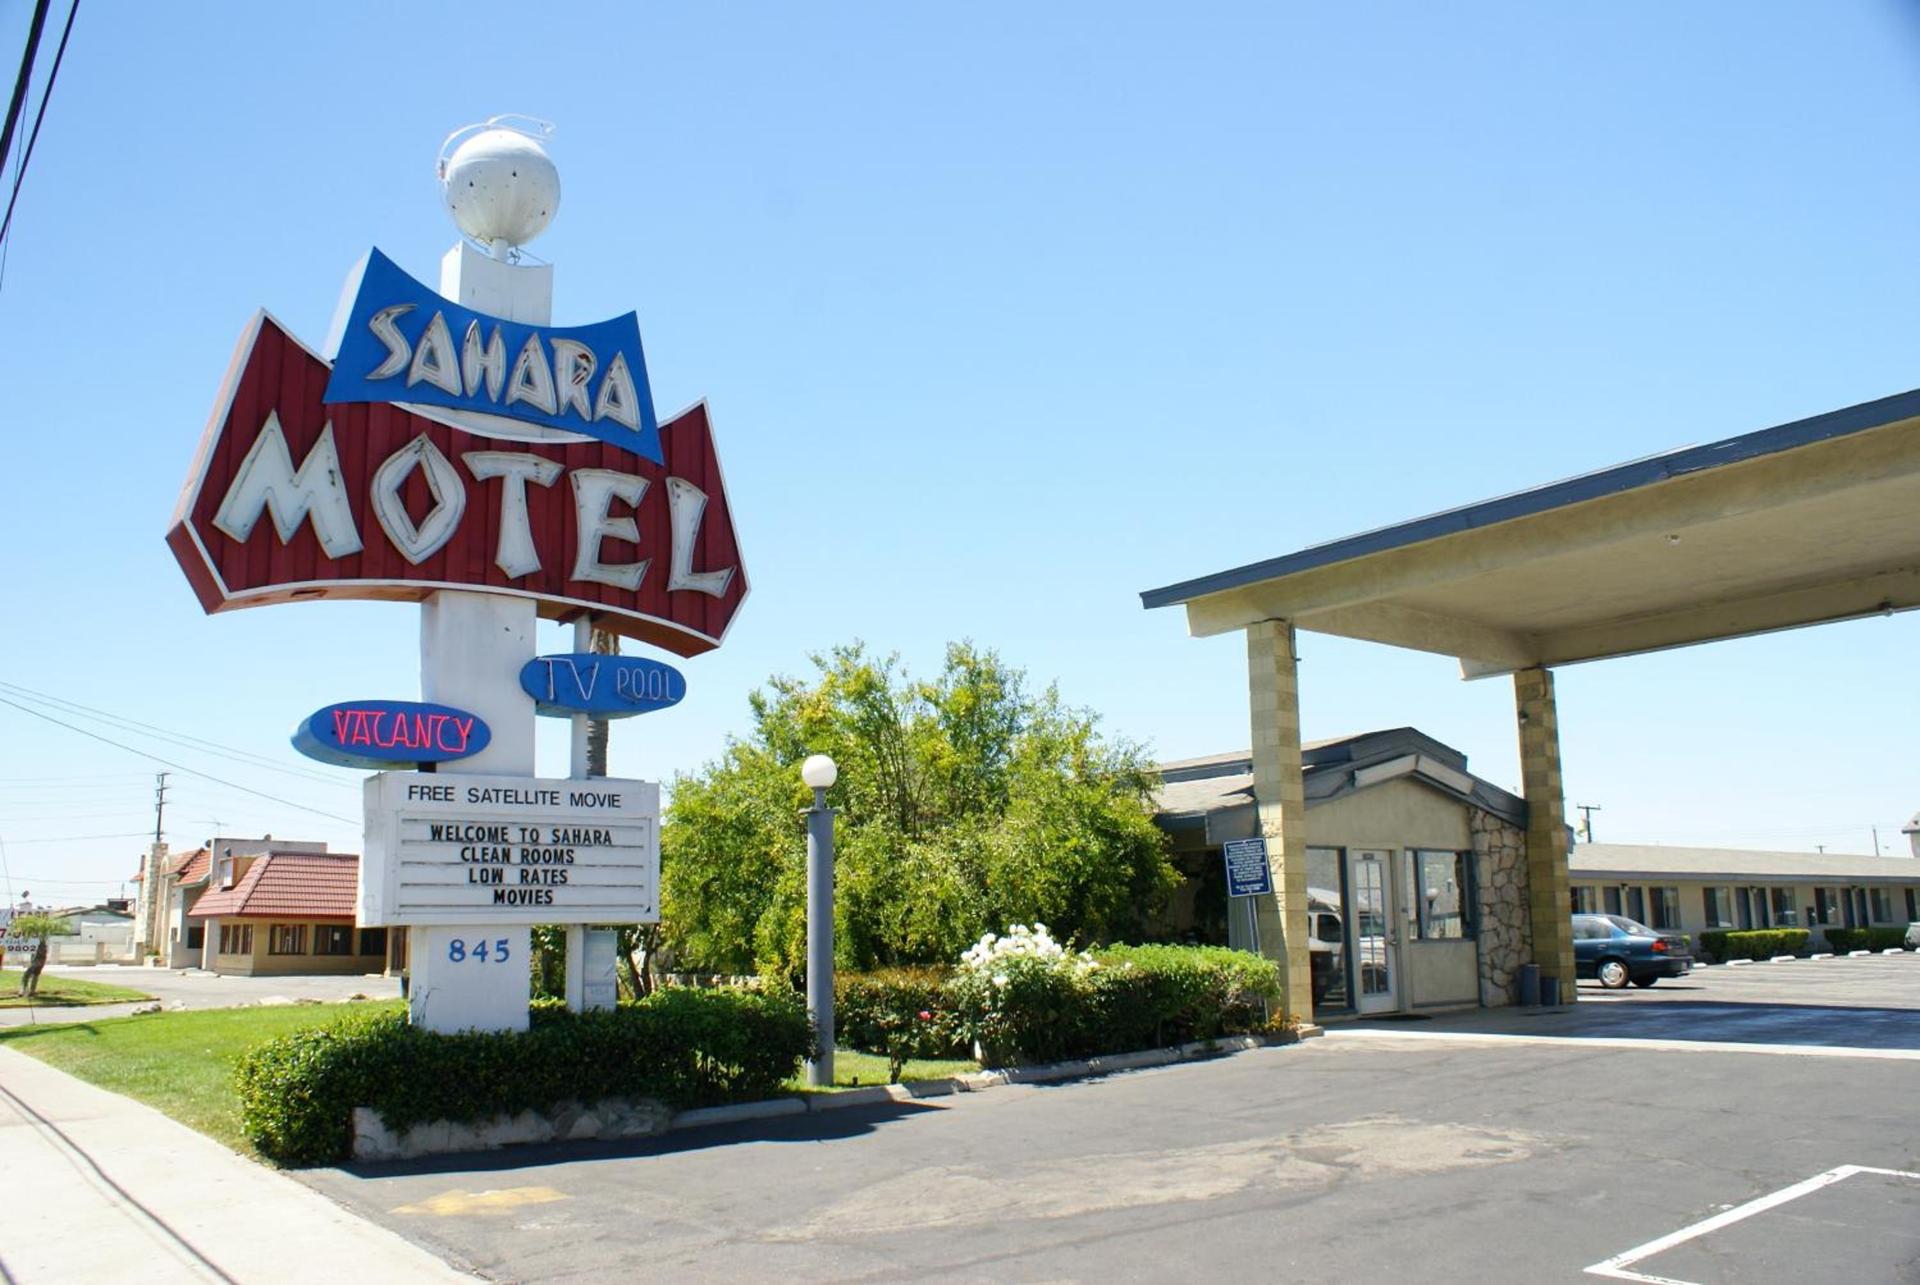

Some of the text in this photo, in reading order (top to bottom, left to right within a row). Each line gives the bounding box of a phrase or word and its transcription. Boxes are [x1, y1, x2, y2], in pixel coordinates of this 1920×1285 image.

[366, 303, 642, 432] SAHARA
[211, 408, 738, 599] MOTEL
[537, 657, 676, 701] TV POOL
[333, 710, 474, 753] VACANCY
[408, 785, 621, 808] FREE SATELLITE MOVIE
[430, 824, 613, 845] WELCOME TO SAHARA
[460, 846, 575, 864] CLEAN ROOMS
[469, 868, 568, 884] LOW RATES
[493, 889, 553, 905] MOVIES
[449, 938, 510, 963] 845
